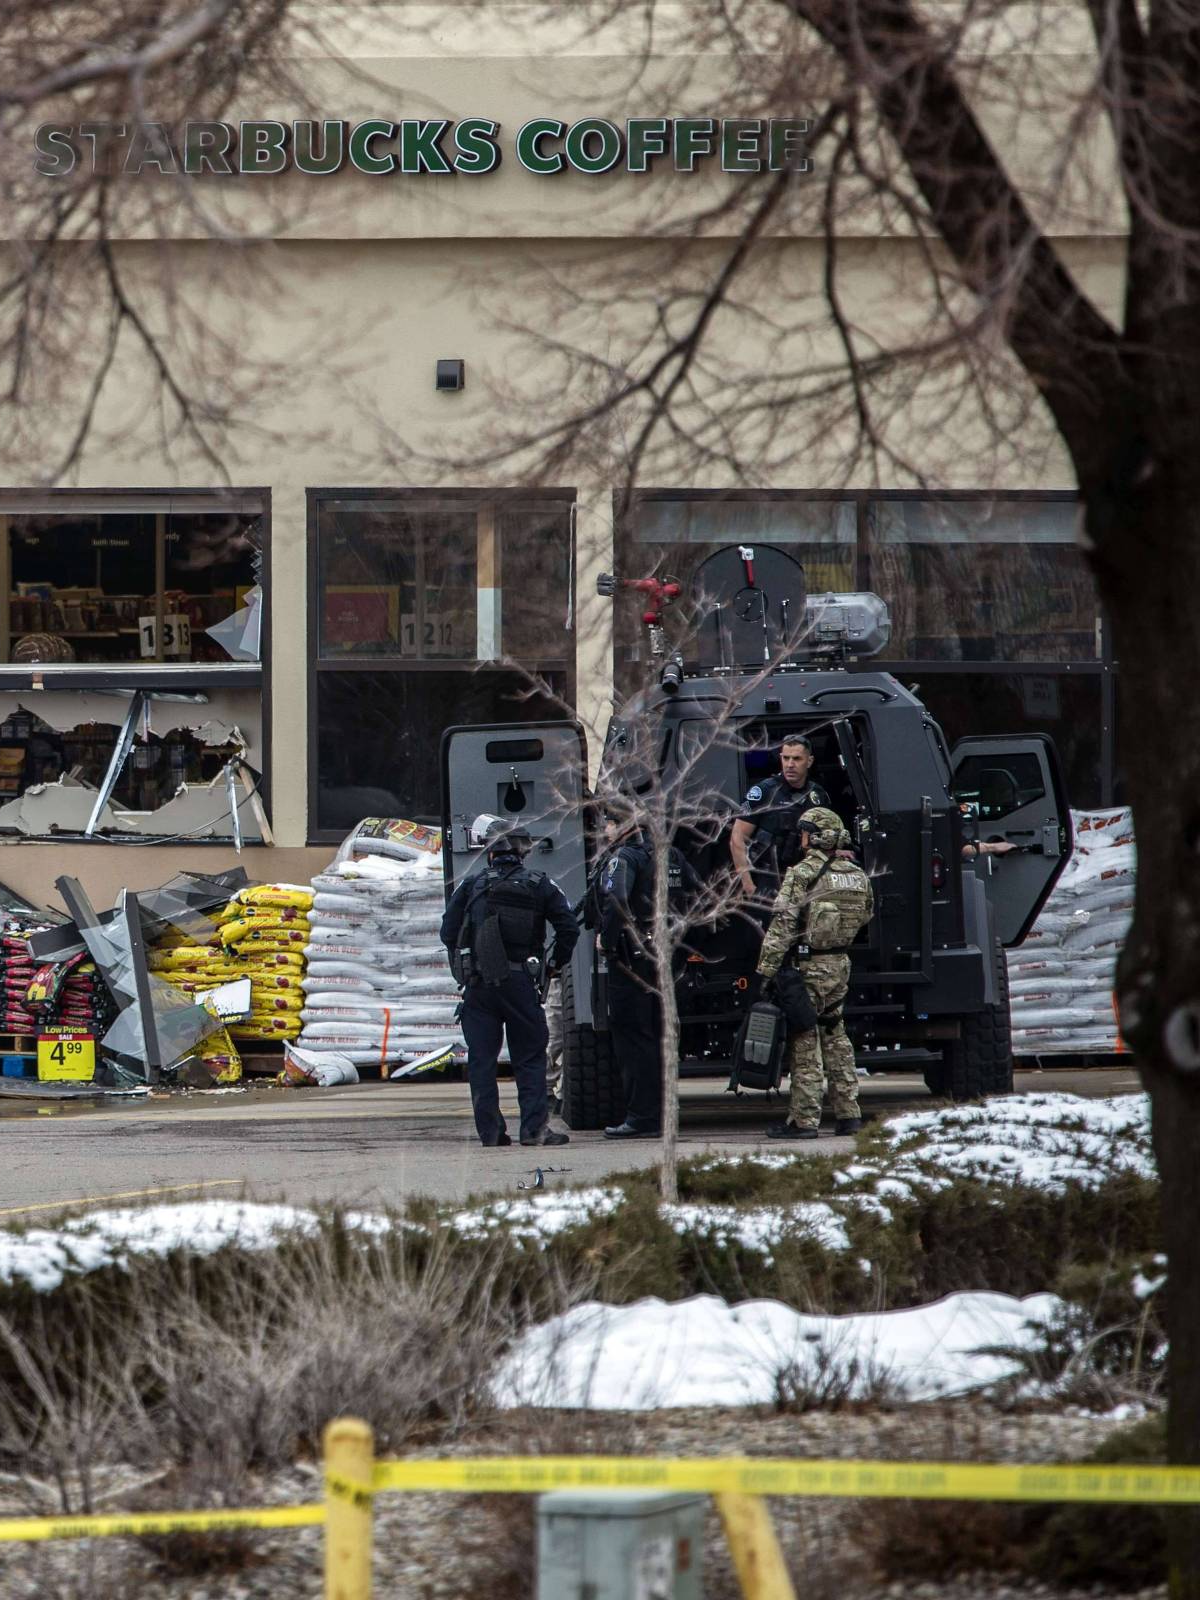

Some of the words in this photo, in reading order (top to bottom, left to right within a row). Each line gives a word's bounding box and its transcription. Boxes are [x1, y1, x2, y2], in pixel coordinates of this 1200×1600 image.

[33, 117, 498, 176] STARBUCKS
[516, 117, 814, 175] COFFEE
[142, 623, 175, 647] 13
[179, 624, 191, 646] 13
[404, 622, 435, 645] 12
[830, 873, 863, 890] POLICE
[45, 1026, 62, 1034] Low
[63, 1026, 88, 1034] Prices
